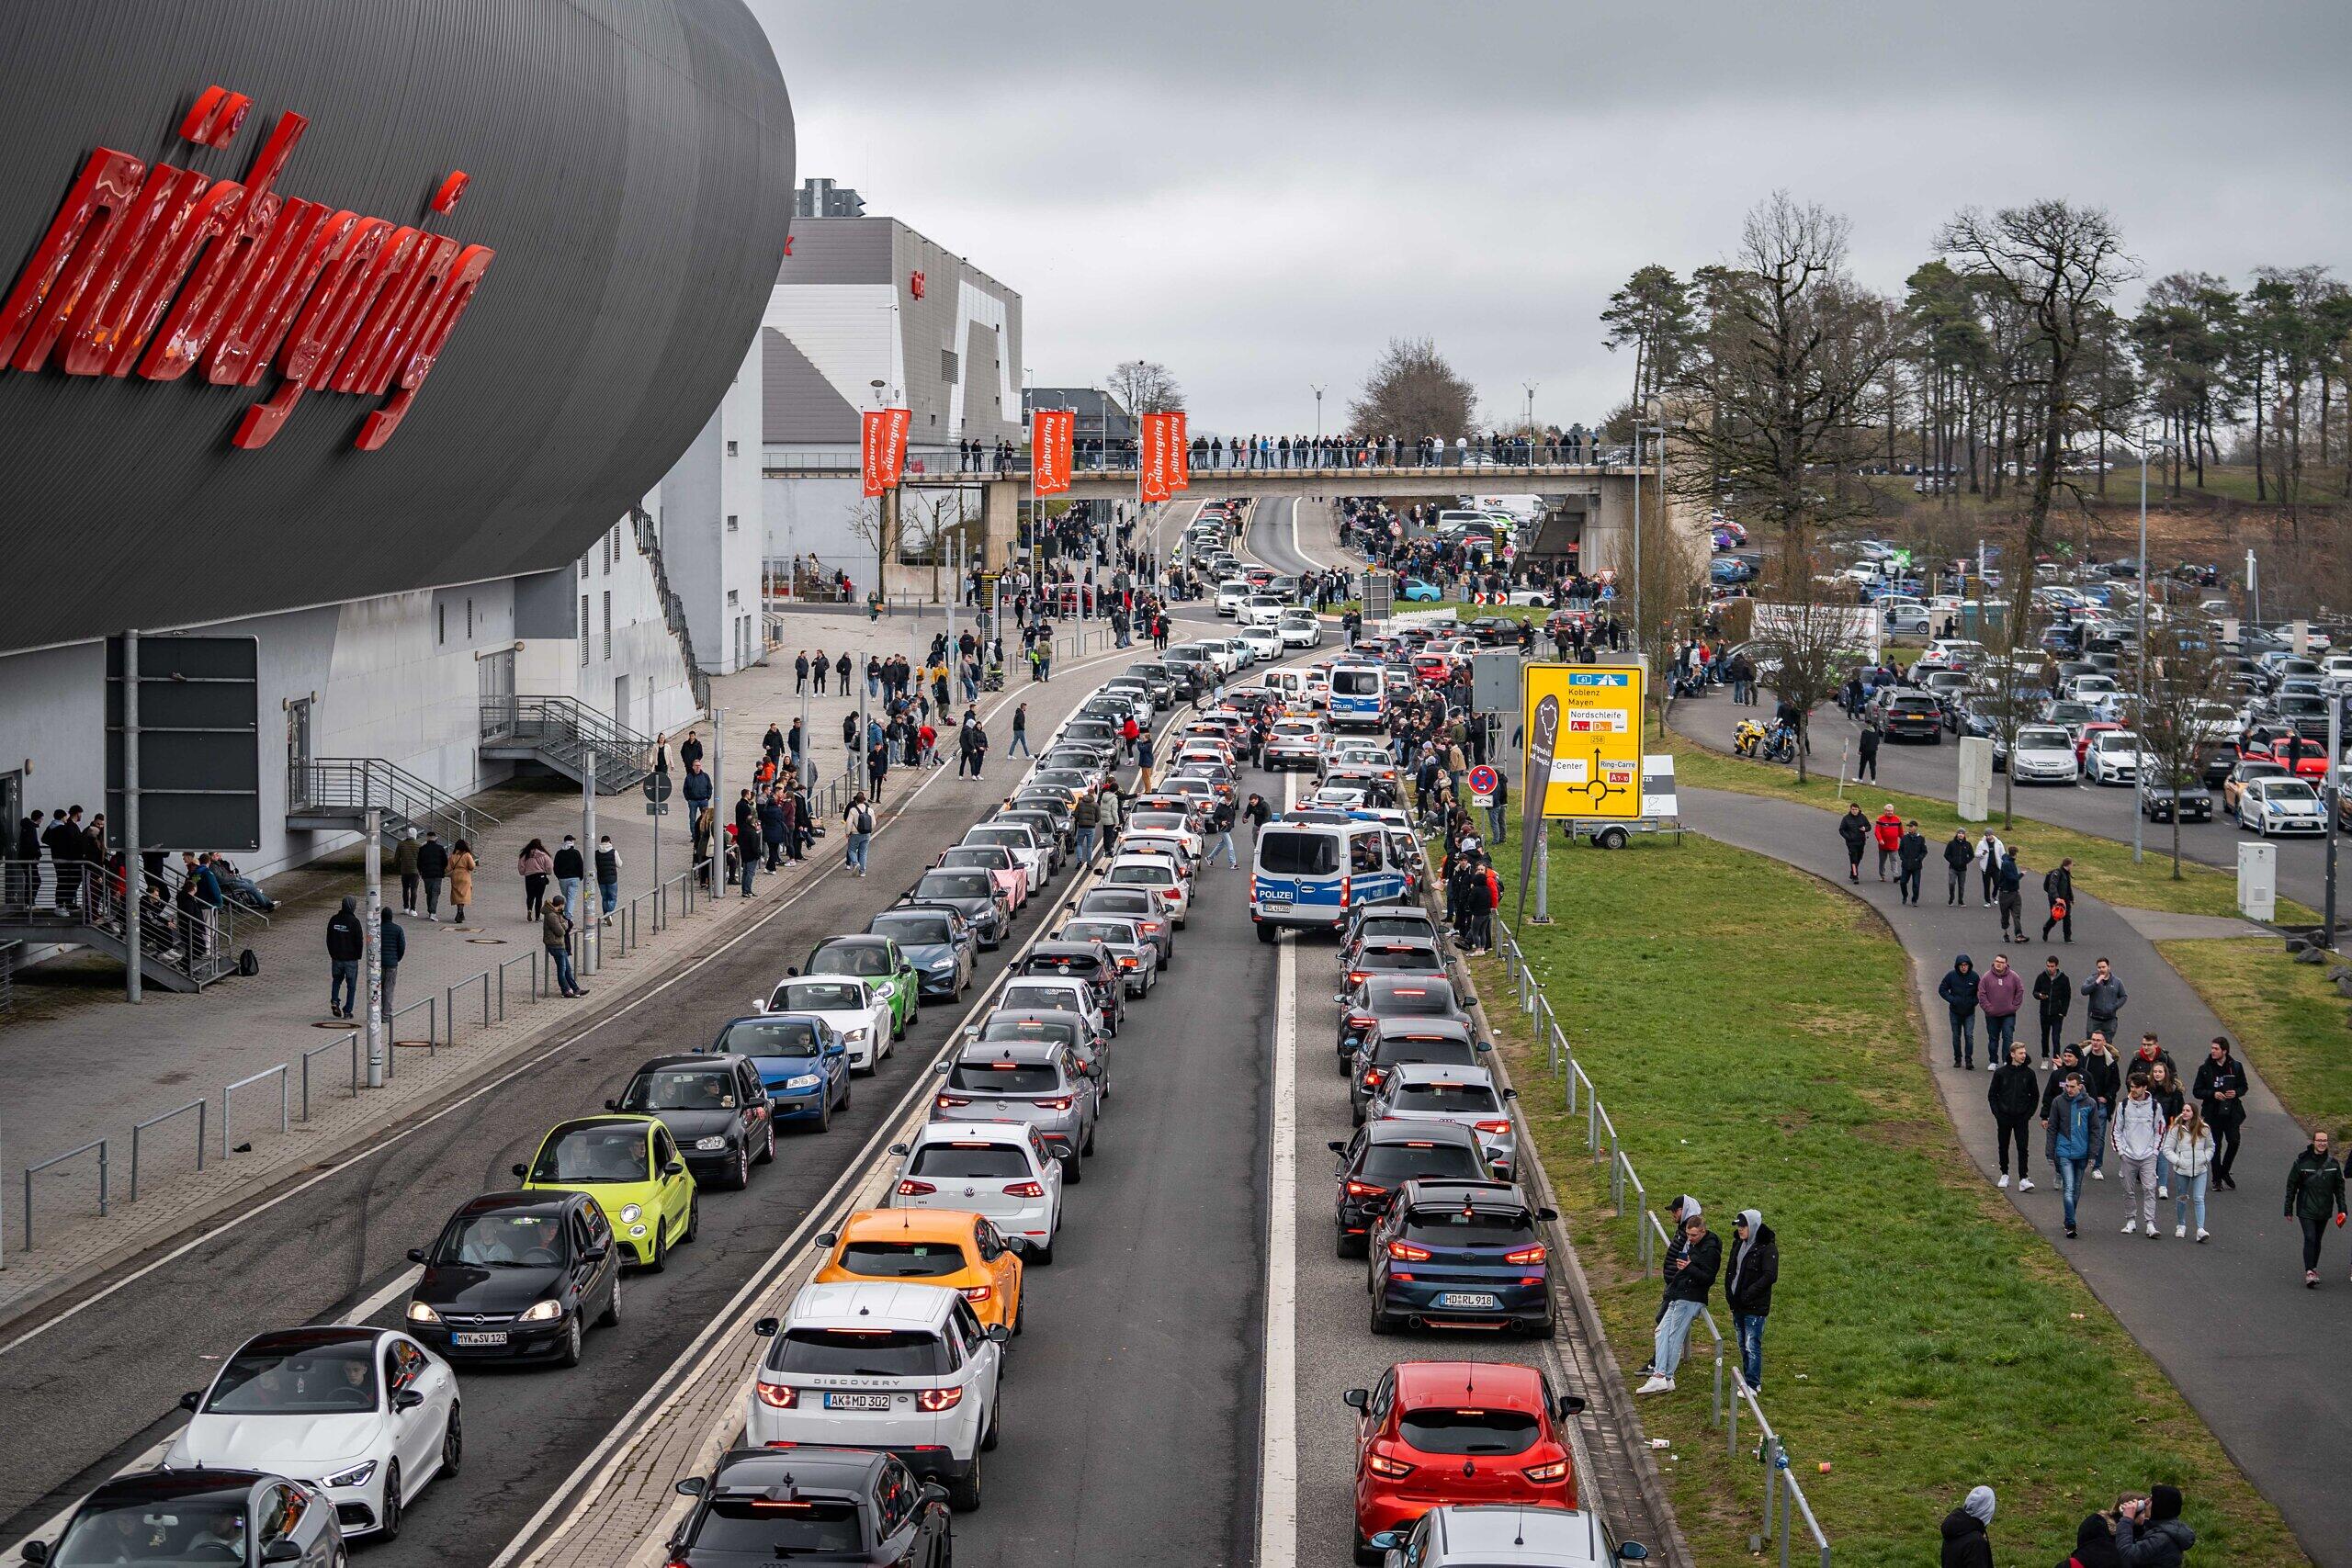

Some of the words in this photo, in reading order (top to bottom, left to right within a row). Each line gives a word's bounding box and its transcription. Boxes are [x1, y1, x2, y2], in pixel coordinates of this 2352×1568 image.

[0, 85, 495, 450] nürburgring
[1568, 688, 1600, 696] Koblenz
[1568, 698, 1594, 707] Mayen
[1570, 711, 1622, 719] Nordschleife
[1572, 722, 1579, 730] A
[1553, 761, 1583, 770] -Center
[1260, 890, 1294, 899] POLIZEI
[1445, 1295, 1457, 1304] HD
[1462, 1295, 1474, 1304] RL
[1476, 1296, 1492, 1305] 918
[458, 1334, 473, 1343] MYK
[479, 1334, 490, 1343] SV
[491, 1334, 506, 1343] 123
[831, 1395, 845, 1406] AK
[852, 1395, 866, 1407] MD
[868, 1396, 888, 1407] 302
